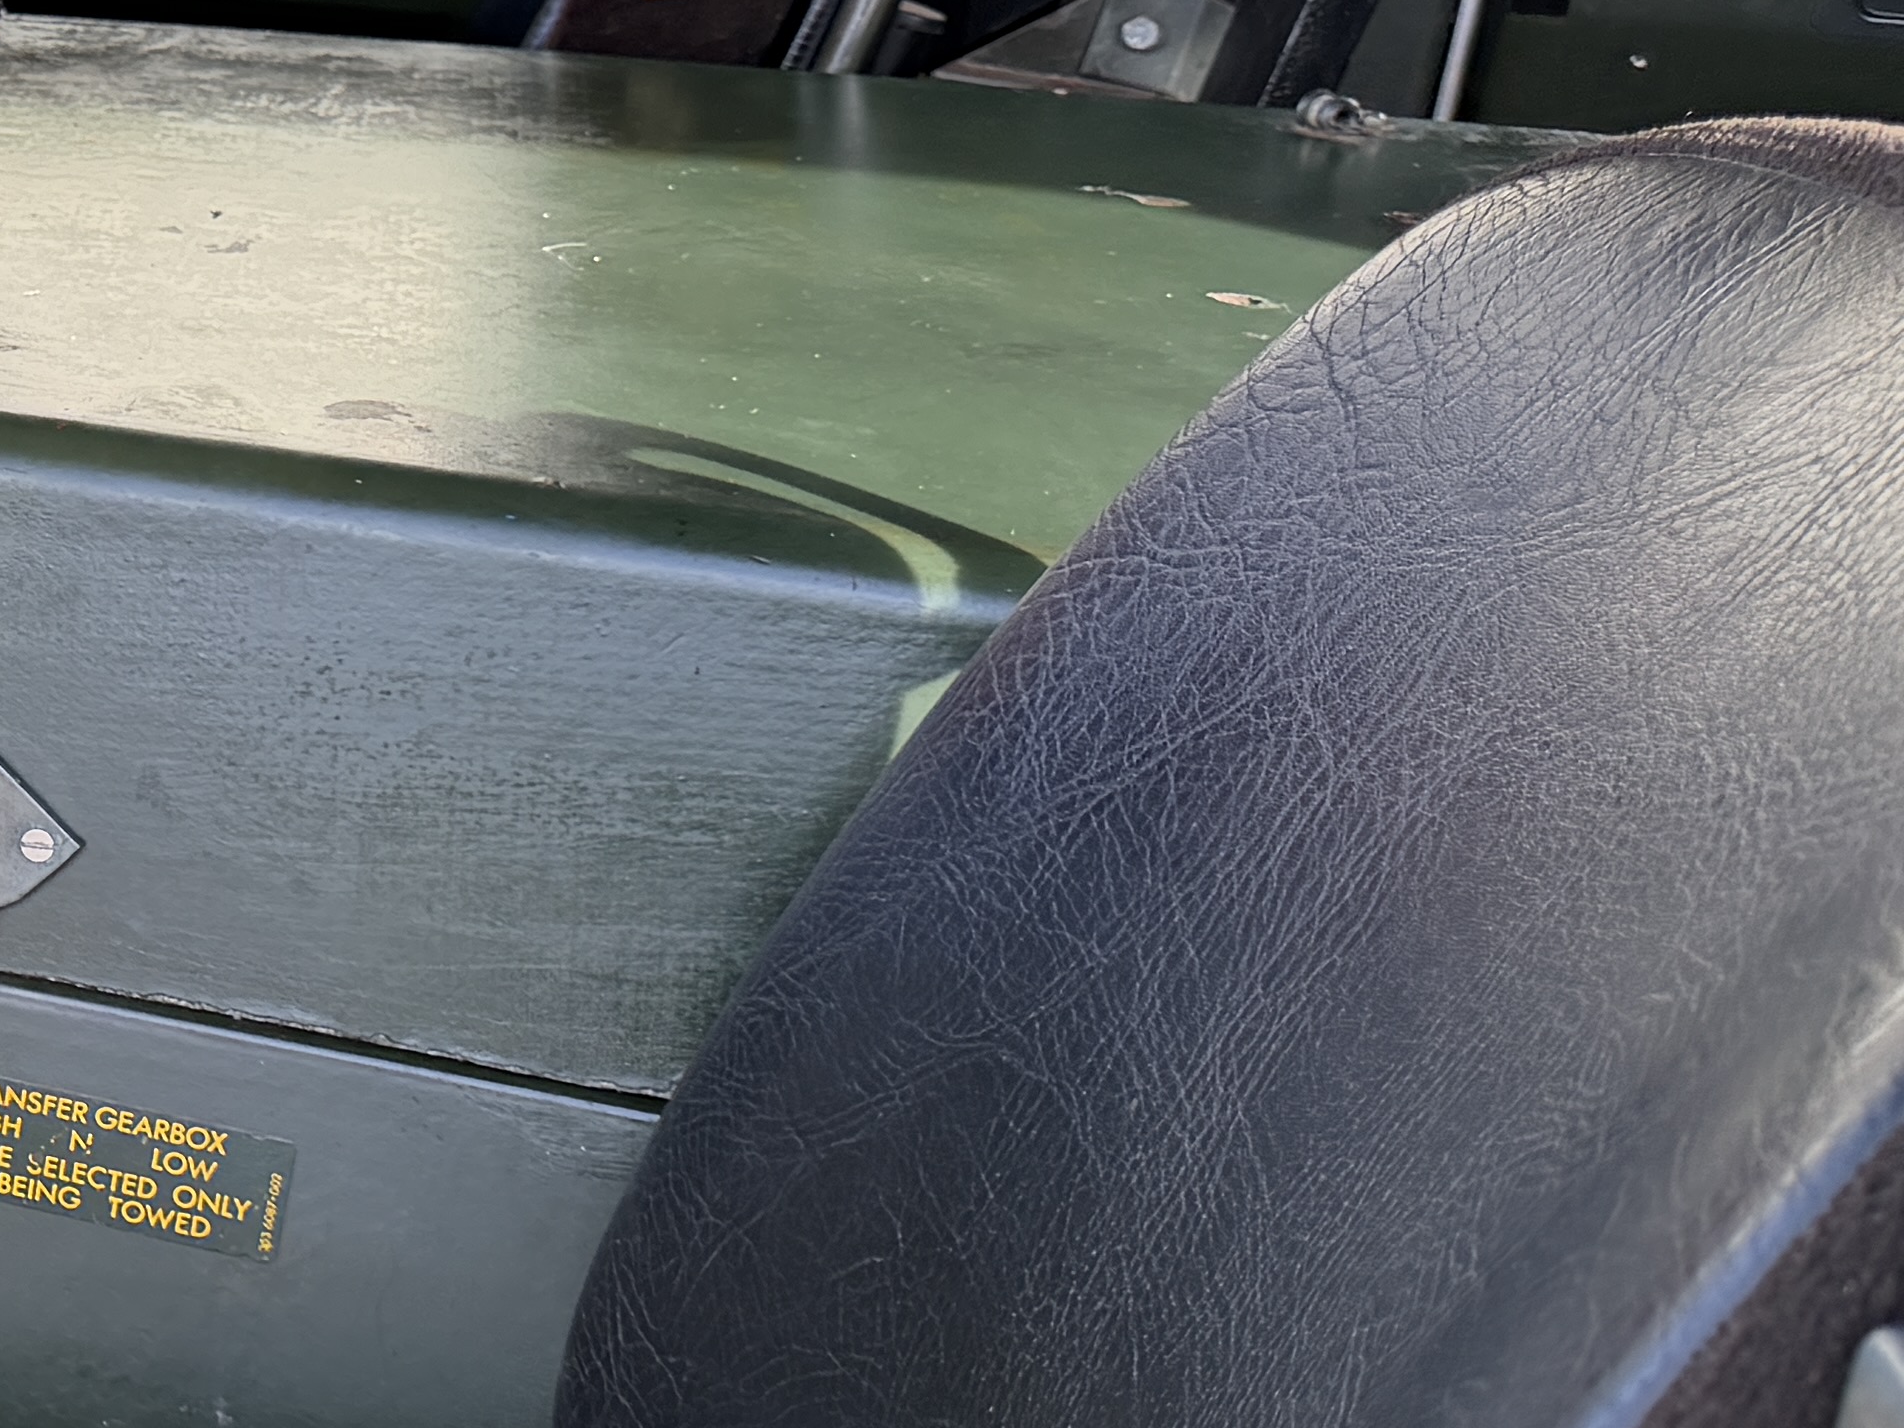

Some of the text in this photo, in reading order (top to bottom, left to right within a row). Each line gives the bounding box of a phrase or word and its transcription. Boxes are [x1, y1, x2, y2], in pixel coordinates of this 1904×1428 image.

[95, 1106, 228, 1156] GEARBOX
[26, 1153, 158, 1199] SELECTED
[172, 1185, 252, 1222] ONLY
[151, 1147, 218, 1182] LOW
[109, 1196, 212, 1238] TOWED
